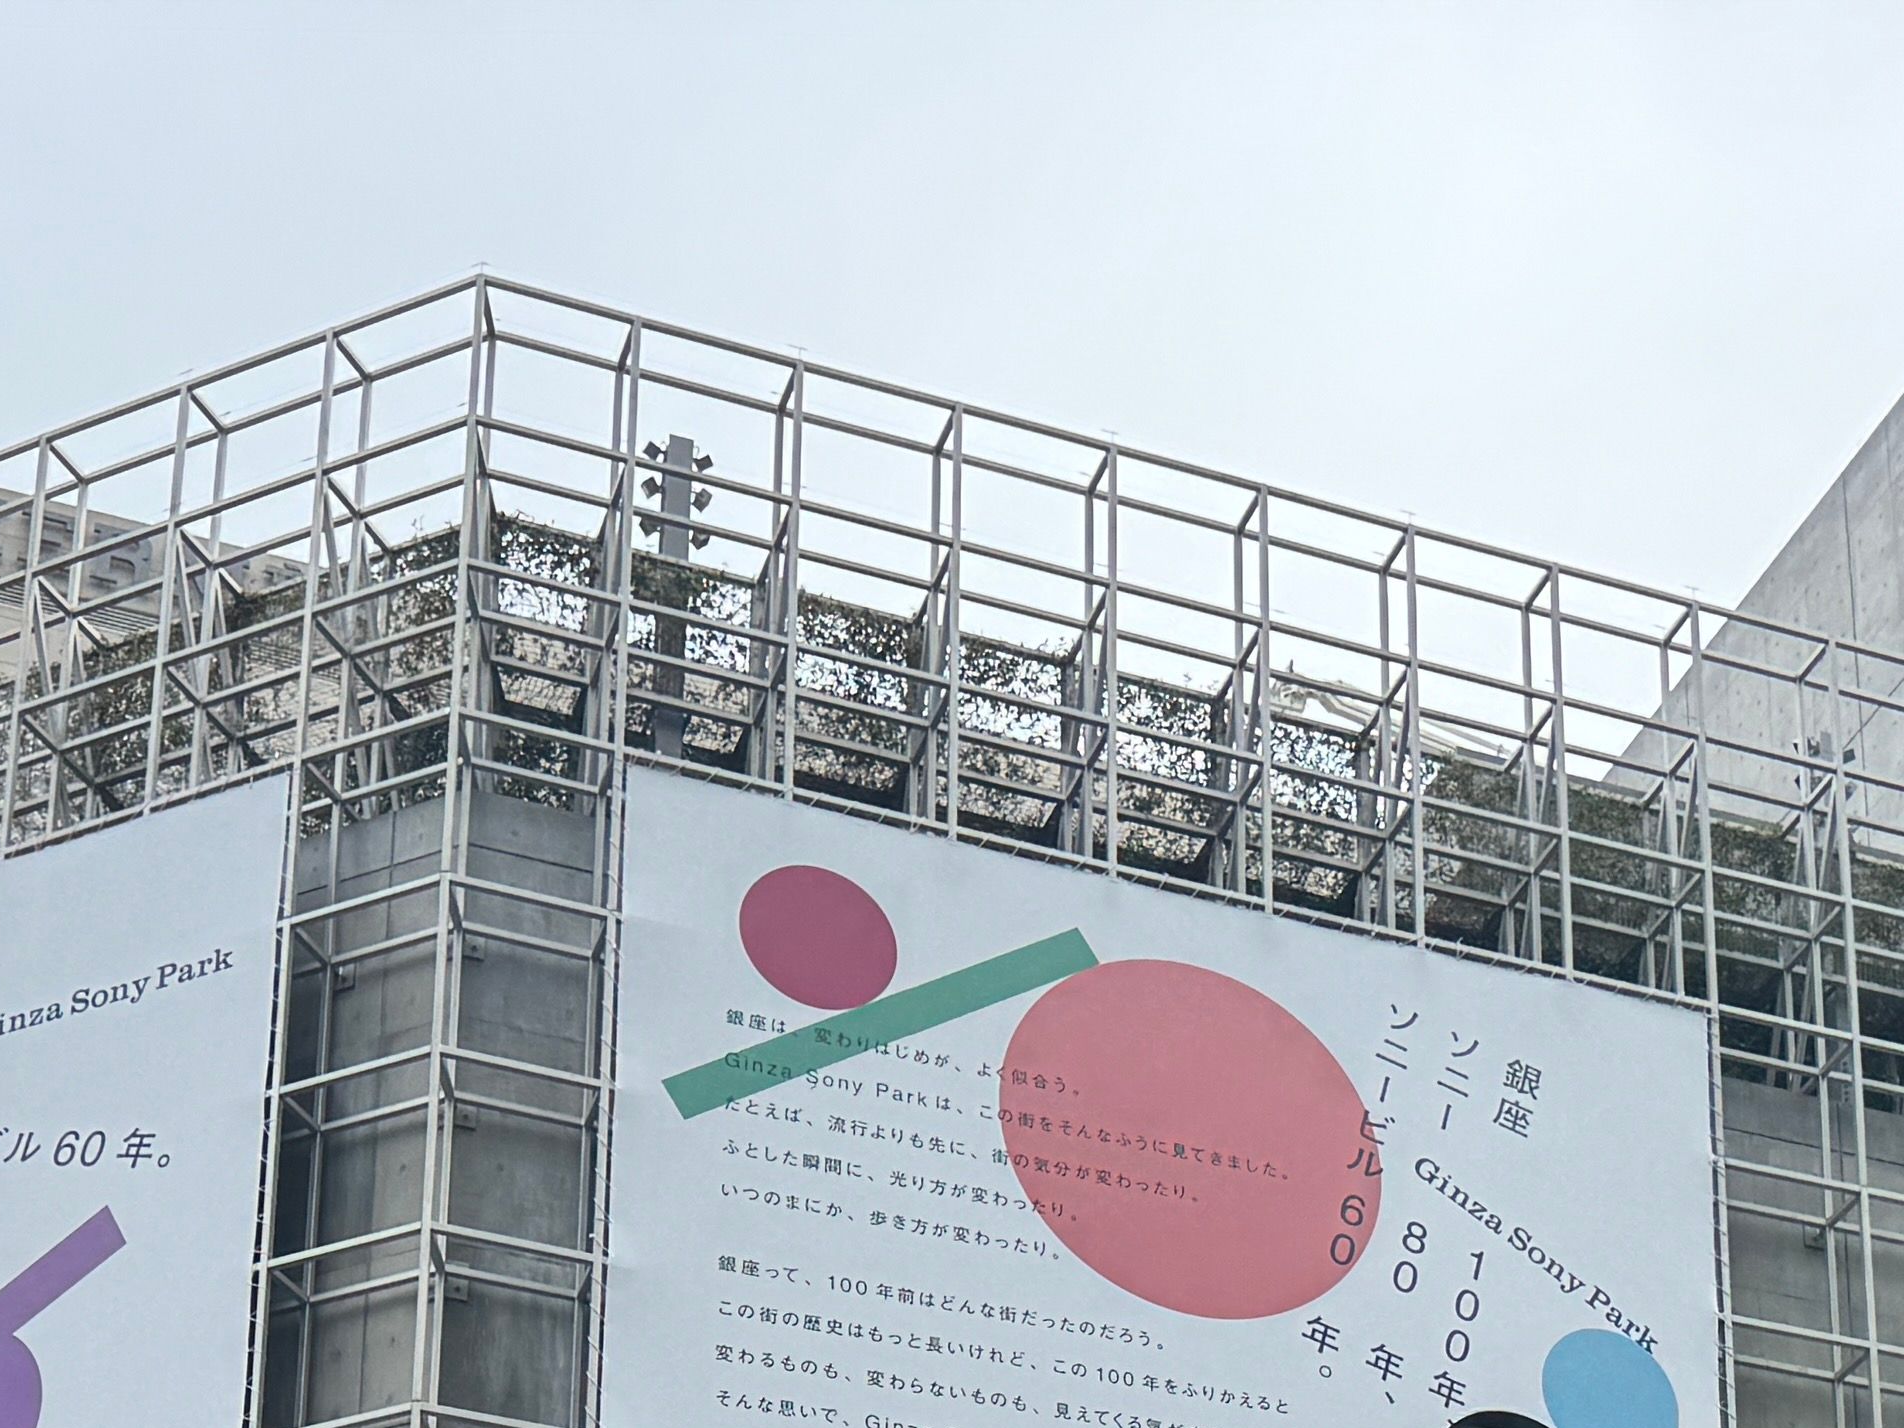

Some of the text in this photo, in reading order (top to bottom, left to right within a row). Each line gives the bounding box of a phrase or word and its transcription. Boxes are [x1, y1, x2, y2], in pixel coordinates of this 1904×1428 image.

[70, 973, 151, 1015] Sony
[153, 946, 234, 990] Park
[724, 1051, 794, 1082] Ginza
[805, 1067, 863, 1098] Sony
[1414, 1157, 1659, 1355] Ginza Sony Park
